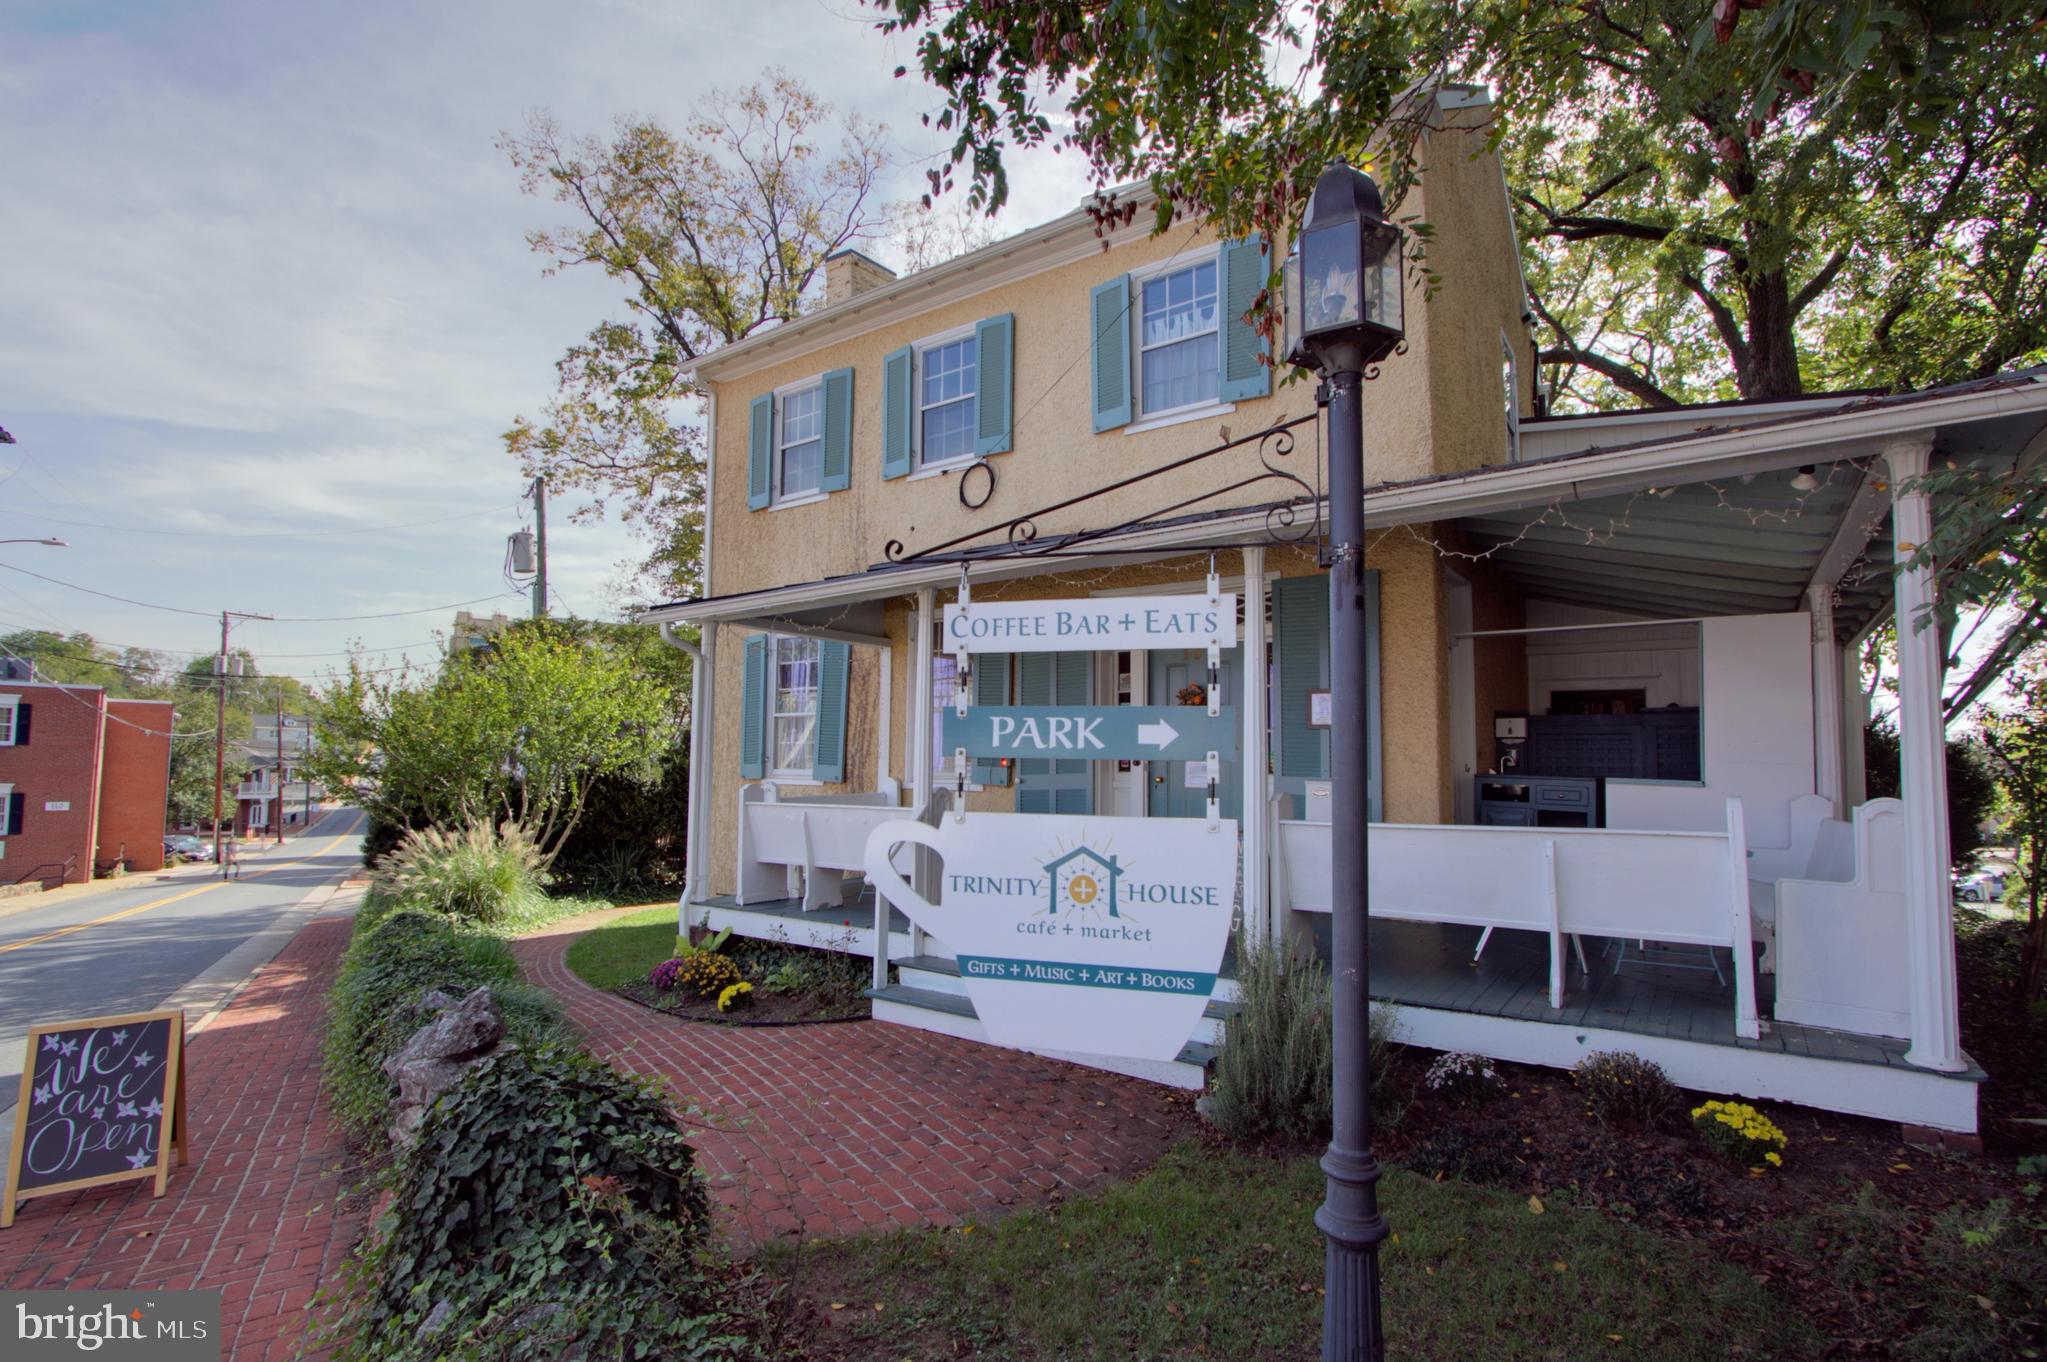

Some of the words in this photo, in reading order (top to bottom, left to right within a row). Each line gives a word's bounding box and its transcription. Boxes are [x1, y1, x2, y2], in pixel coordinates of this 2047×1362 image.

[950, 614, 1046, 638] COFFEE
[1055, 611, 1110, 636] BAR
[1144, 609, 1218, 634] EATS
[989, 715, 1106, 750] PARK
[948, 875, 1042, 897] TRINITY
[1127, 882, 1220, 906] HOUSE
[1016, 919, 1056, 936] café
[1081, 925, 1152, 942] market
[967, 959, 1005, 976] GIFTS
[1023, 964, 1075, 981] MUSIC
[1094, 969, 1125, 985] ART
[1141, 973, 1195, 990] BOOKS
[34, 1025, 148, 1095] We
[55, 1062, 165, 1117] are
[27, 1117, 158, 1174] Open
